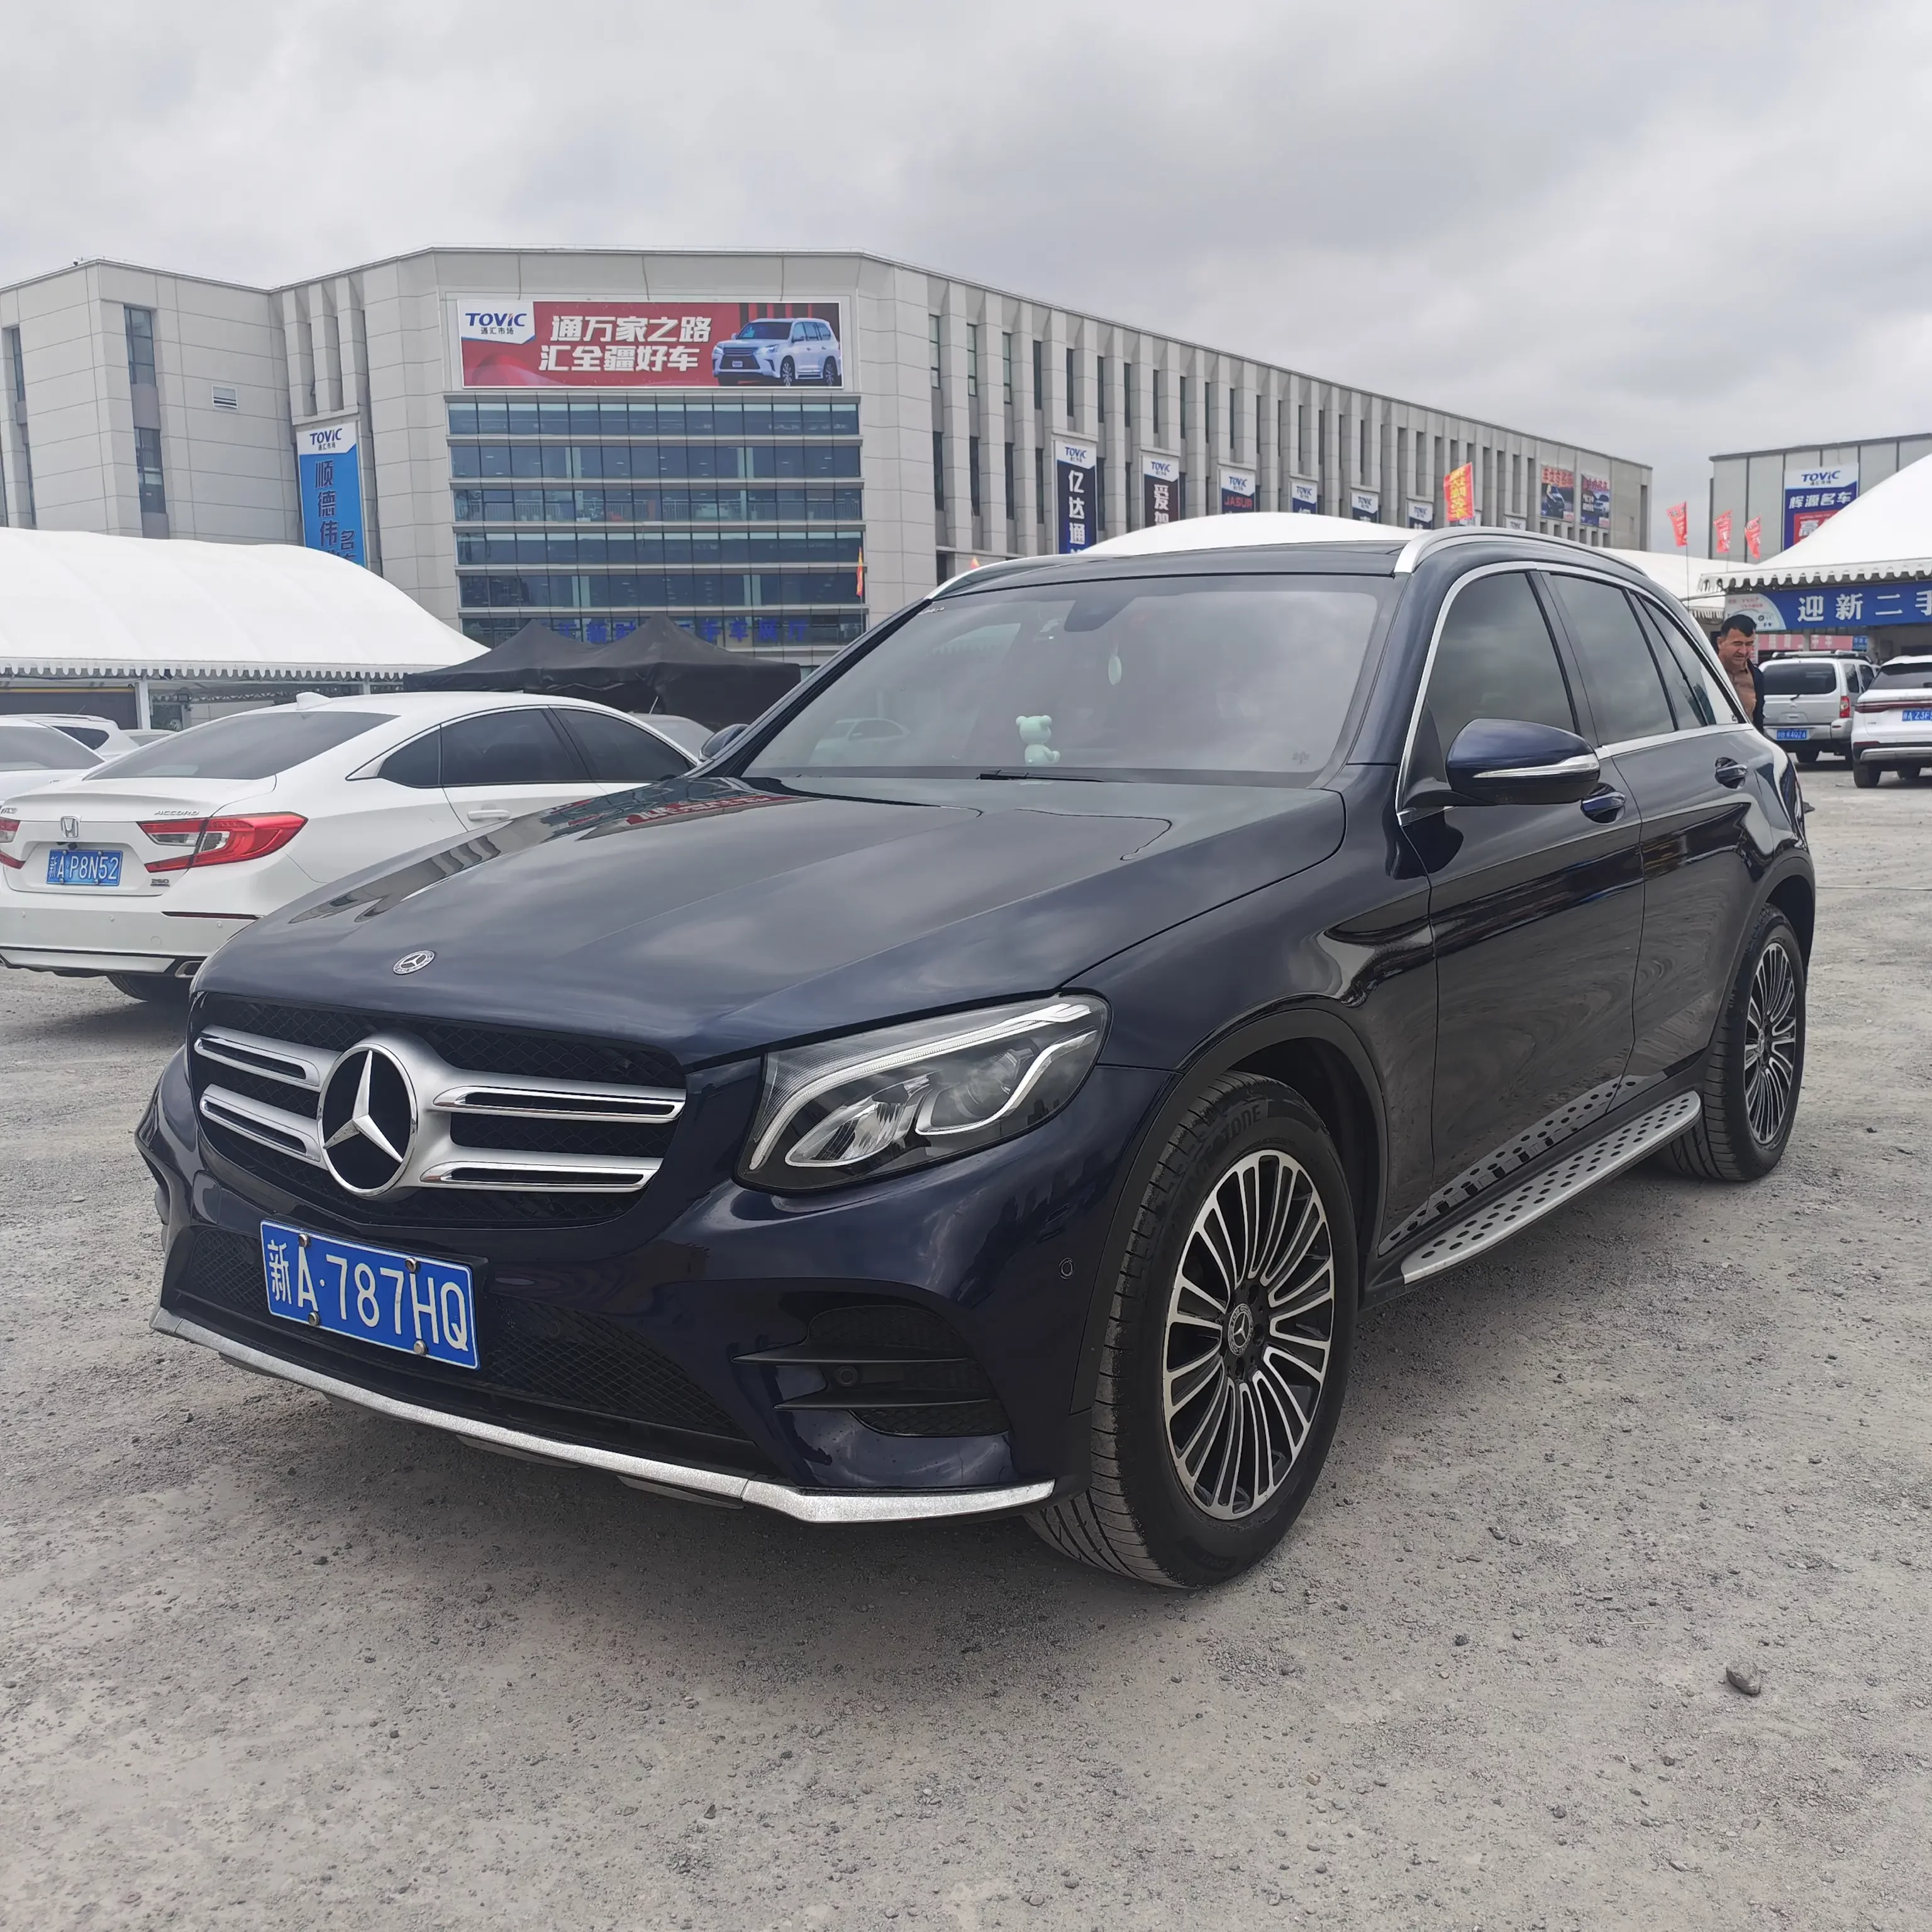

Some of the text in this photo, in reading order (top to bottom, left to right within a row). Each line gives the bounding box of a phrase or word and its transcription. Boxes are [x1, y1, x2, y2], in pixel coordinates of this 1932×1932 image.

[480, 326, 514, 336] 通汇市场
[550, 315, 712, 343] 通万家之路
[538, 344, 700, 372] 汇全疆好车
[315, 460, 341, 556] 顺德伟
[1068, 470, 1085, 553] 亿达通
